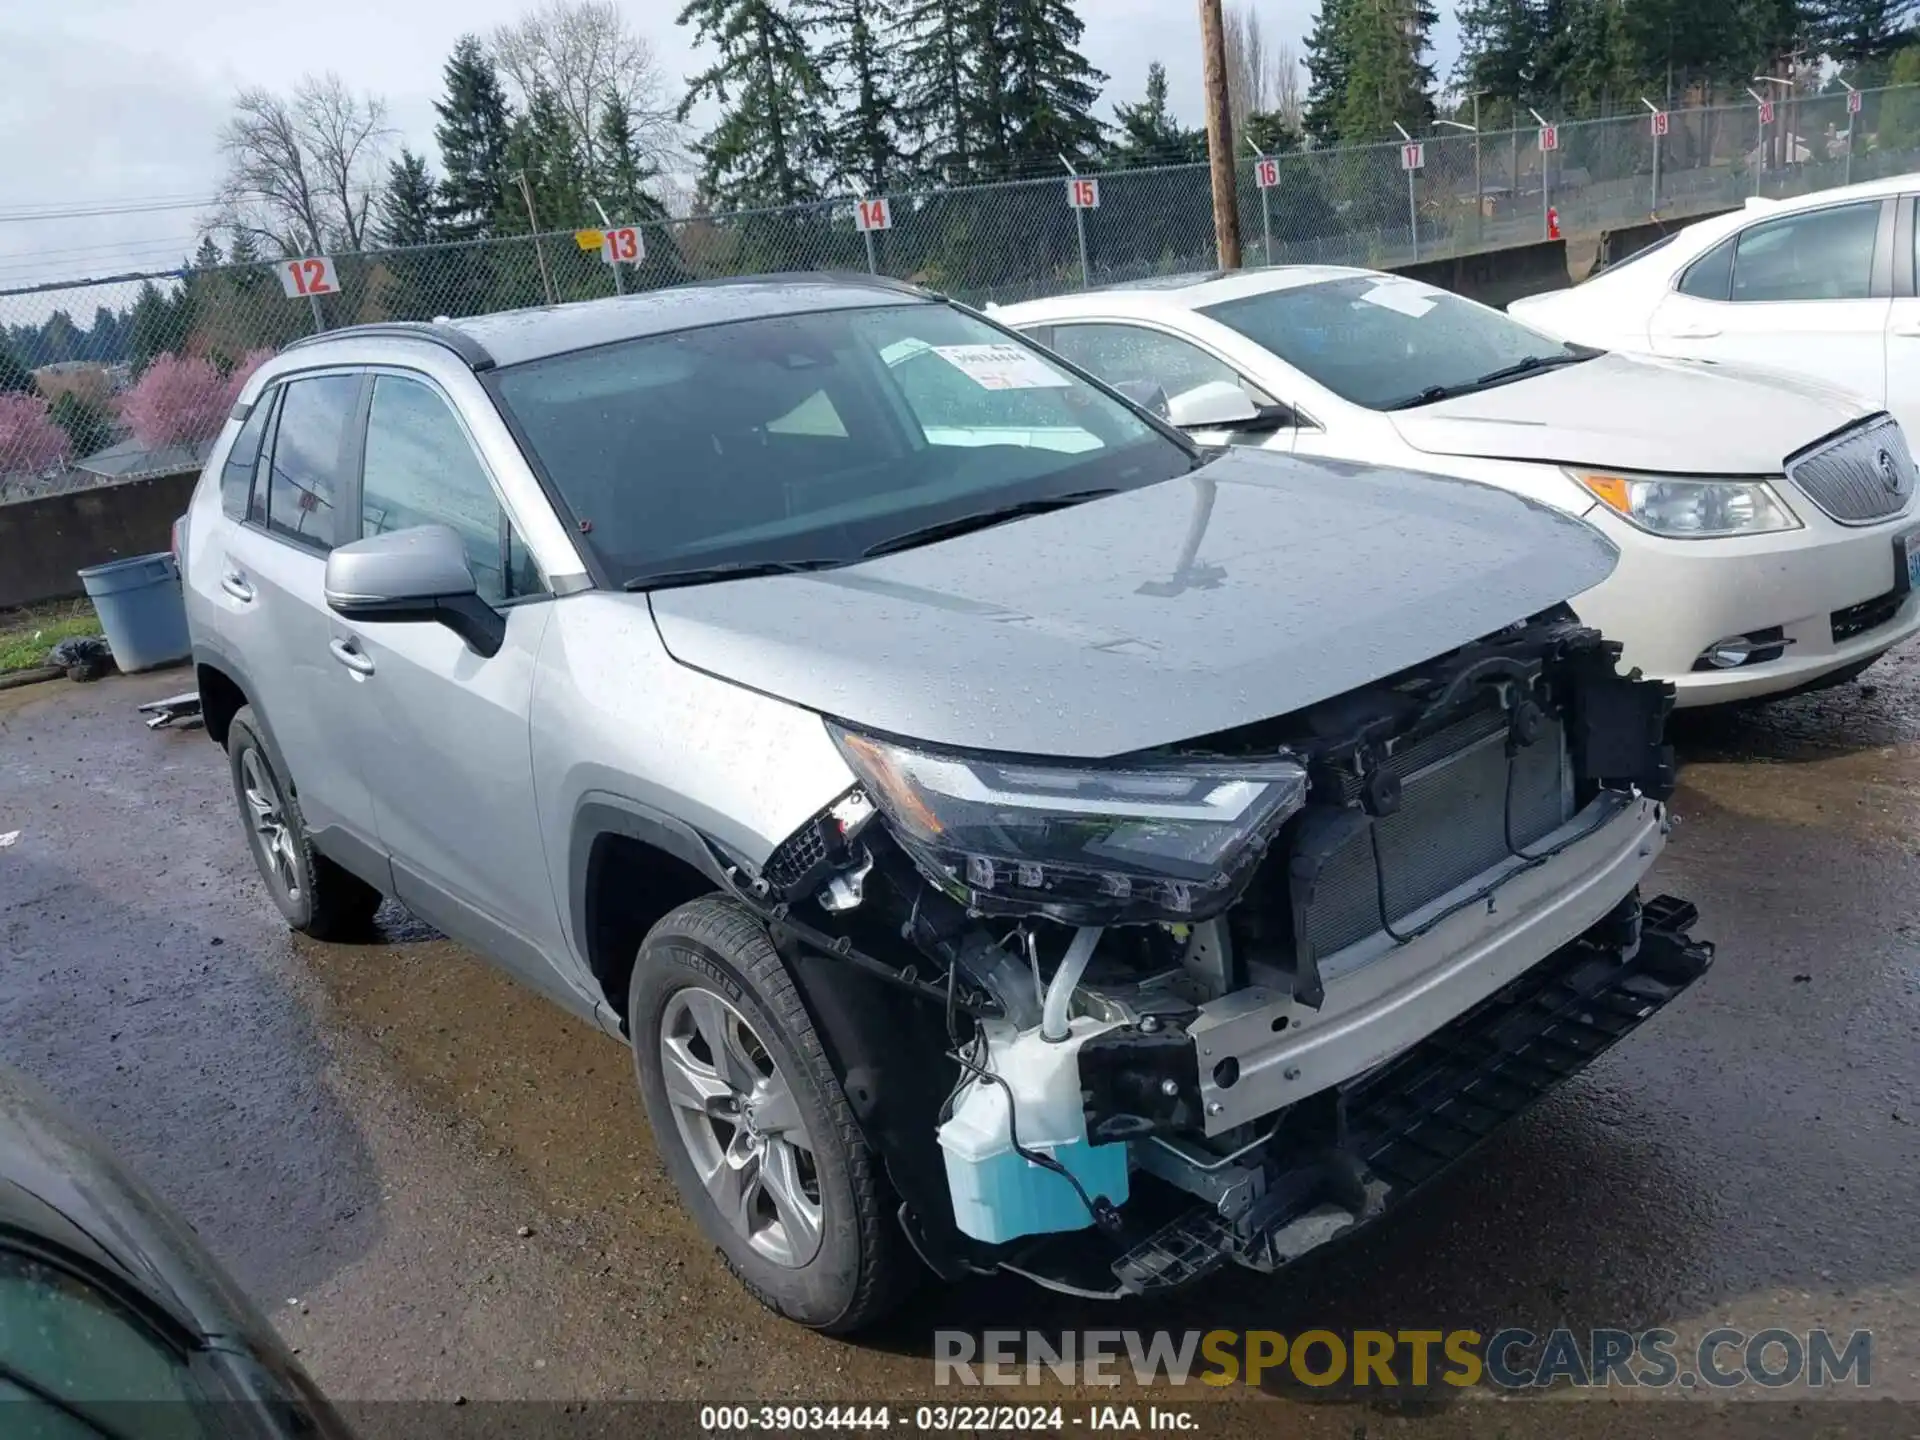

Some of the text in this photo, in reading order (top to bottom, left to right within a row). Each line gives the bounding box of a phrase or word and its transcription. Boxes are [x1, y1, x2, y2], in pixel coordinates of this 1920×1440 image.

[1655, 114, 1666, 134] 19
[1761, 102, 1772, 122] 20
[1542, 128, 1554, 149] 18
[1405, 145, 1420, 168] 17
[1258, 161, 1277, 187] 16
[1073, 181, 1094, 206] 15
[859, 201, 885, 229] 14
[606, 229, 637, 260] 13
[288, 260, 330, 293] 12
